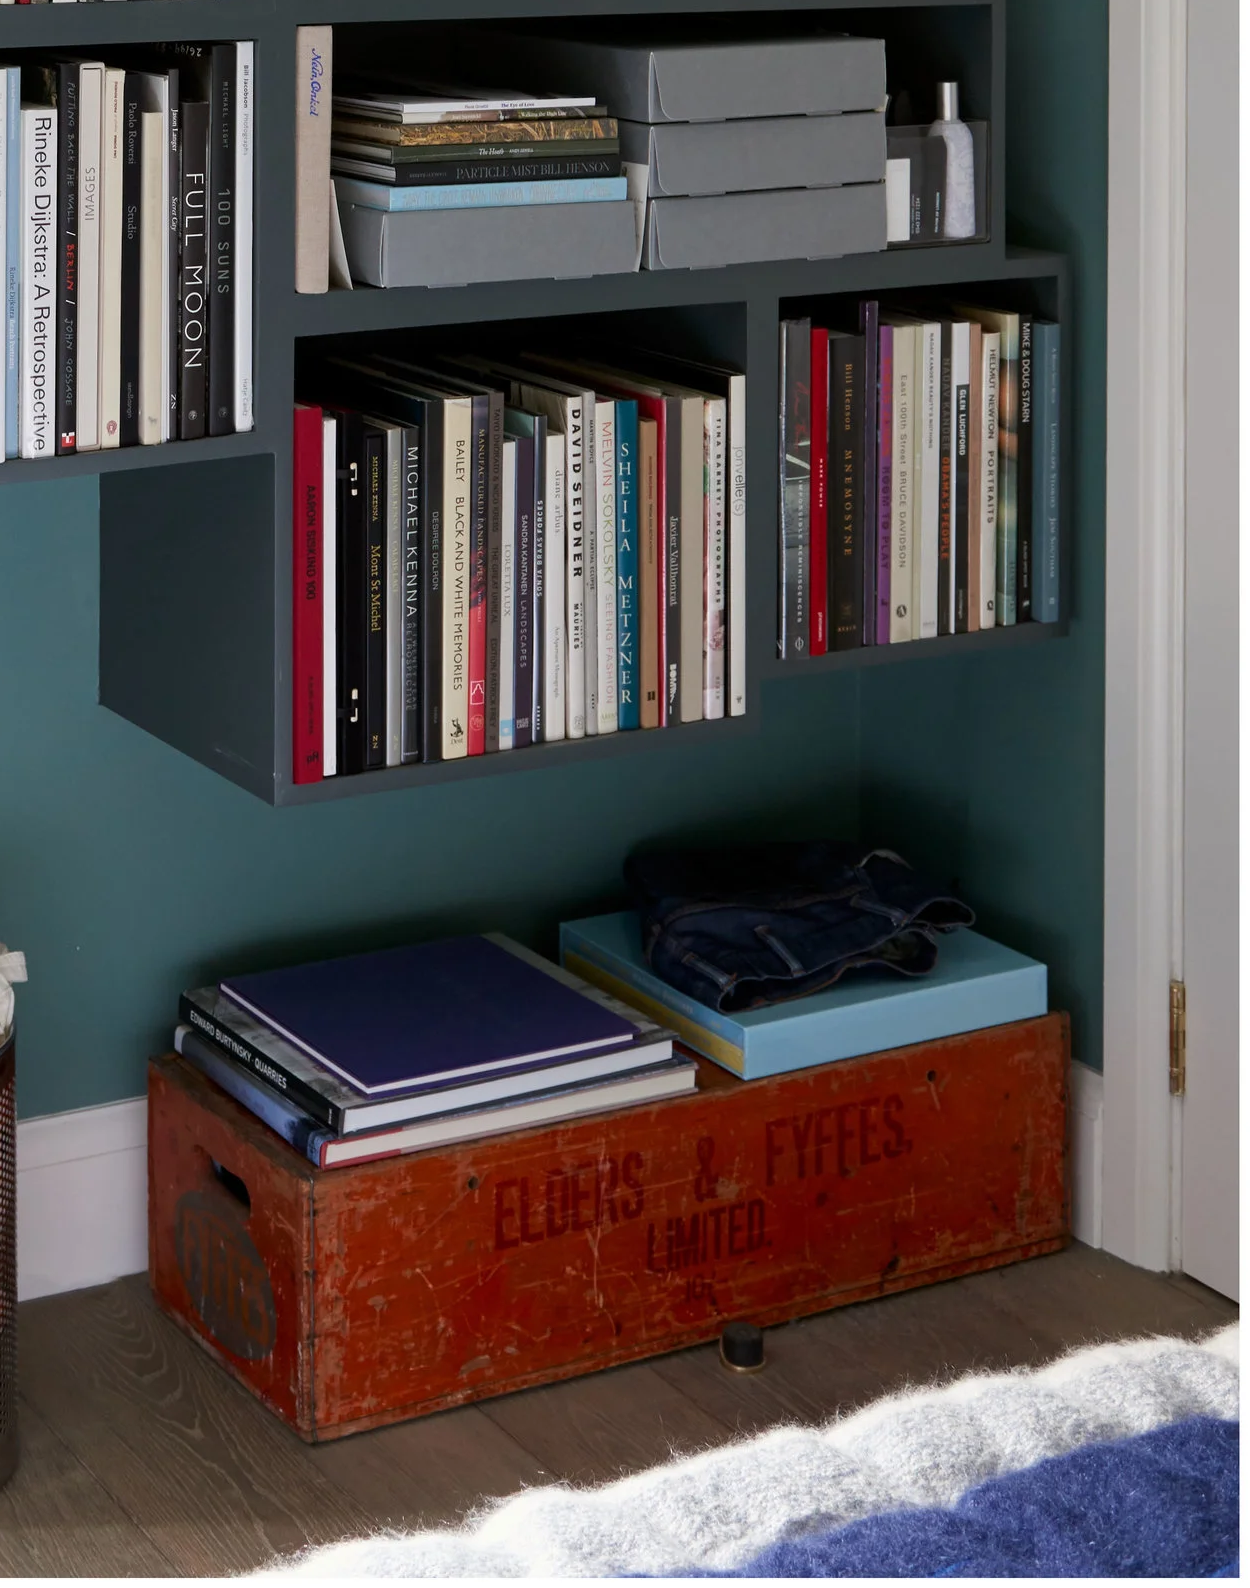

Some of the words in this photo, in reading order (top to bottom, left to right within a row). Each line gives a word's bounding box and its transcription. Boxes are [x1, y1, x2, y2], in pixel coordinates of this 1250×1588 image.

[32, 117, 52, 188] Rineke
[456, 166, 509, 180] PARTICLE
[511, 165, 538, 176] MIST
[540, 164, 564, 176] BILL
[566, 161, 610, 174] HENSON
[184, 173, 204, 246] FULL
[217, 189, 231, 226] 100
[28, 194, 52, 278] Dijkstra:
[33, 284, 50, 300] A
[216, 242, 230, 295] SUNS
[184, 265, 203, 368] MOON
[1021, 323, 1030, 348] MIKE
[26, 307, 50, 451] Retrospective
[988, 349, 997, 389] HELMUT
[1021, 359, 1030, 387] DOUG
[987, 394, 996, 439] NEWTON
[1021, 390, 1030, 423] STARN
[455, 440, 465, 482] BAILEY
[570, 409, 583, 476] DAVID
[406, 447, 418, 541] MICHAEL
[619, 443, 632, 552] SHEILA
[986, 450, 995, 523] PORTRAITS
[454, 496, 464, 538] BLACK
[572, 482, 584, 578] SEIDNER
[371, 545, 381, 576] Mont
[406, 546, 418, 617] KENNA
[454, 541, 464, 572] AND
[371, 580, 381, 591] St
[453, 576, 464, 619] WHITE
[371, 595, 381, 631] Michel
[452, 623, 463, 691] MEMORIES
[618, 576, 632, 704] METZNER
[190, 1009, 215, 1037] EDWARD
[215, 1030, 251, 1064] BURTYNSKY
[254, 1059, 287, 1090] QUARRIES
[494, 1150, 644, 1252] ELDERS
[694, 1135, 719, 1203] &
